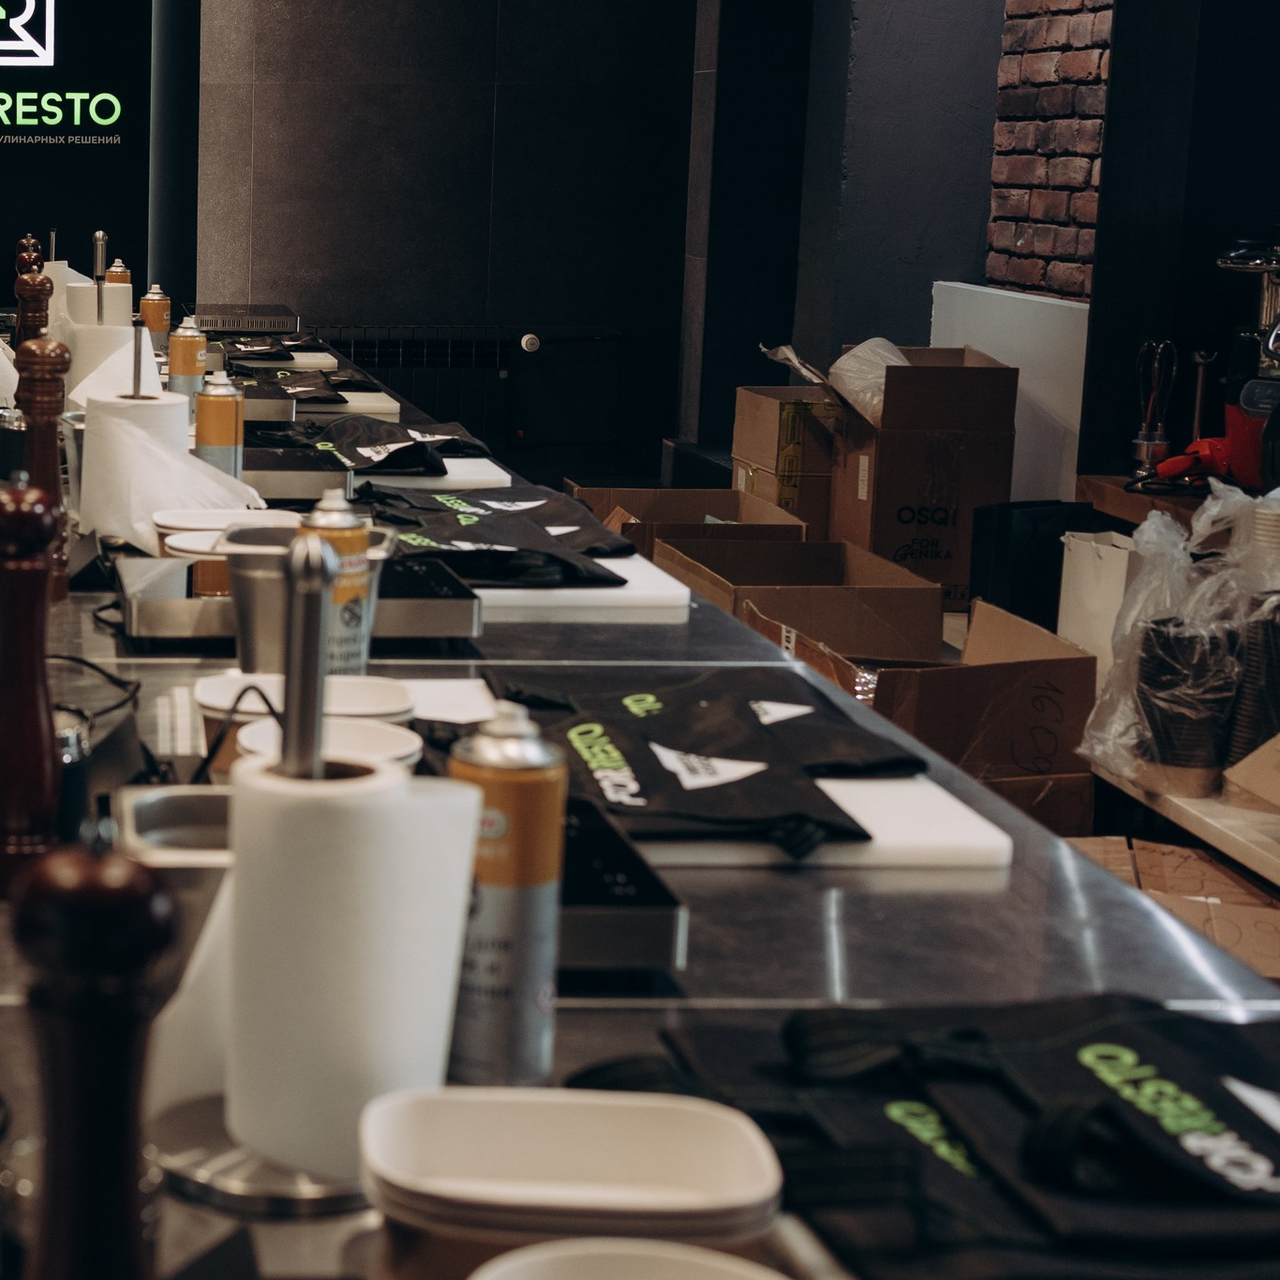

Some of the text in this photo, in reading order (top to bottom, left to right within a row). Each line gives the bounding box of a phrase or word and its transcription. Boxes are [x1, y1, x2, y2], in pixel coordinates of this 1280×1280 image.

[67, 133, 121, 145] РЕШЕНИЙ
[911, 538, 940, 550] FOR
[893, 543, 953, 562] GENIKA
